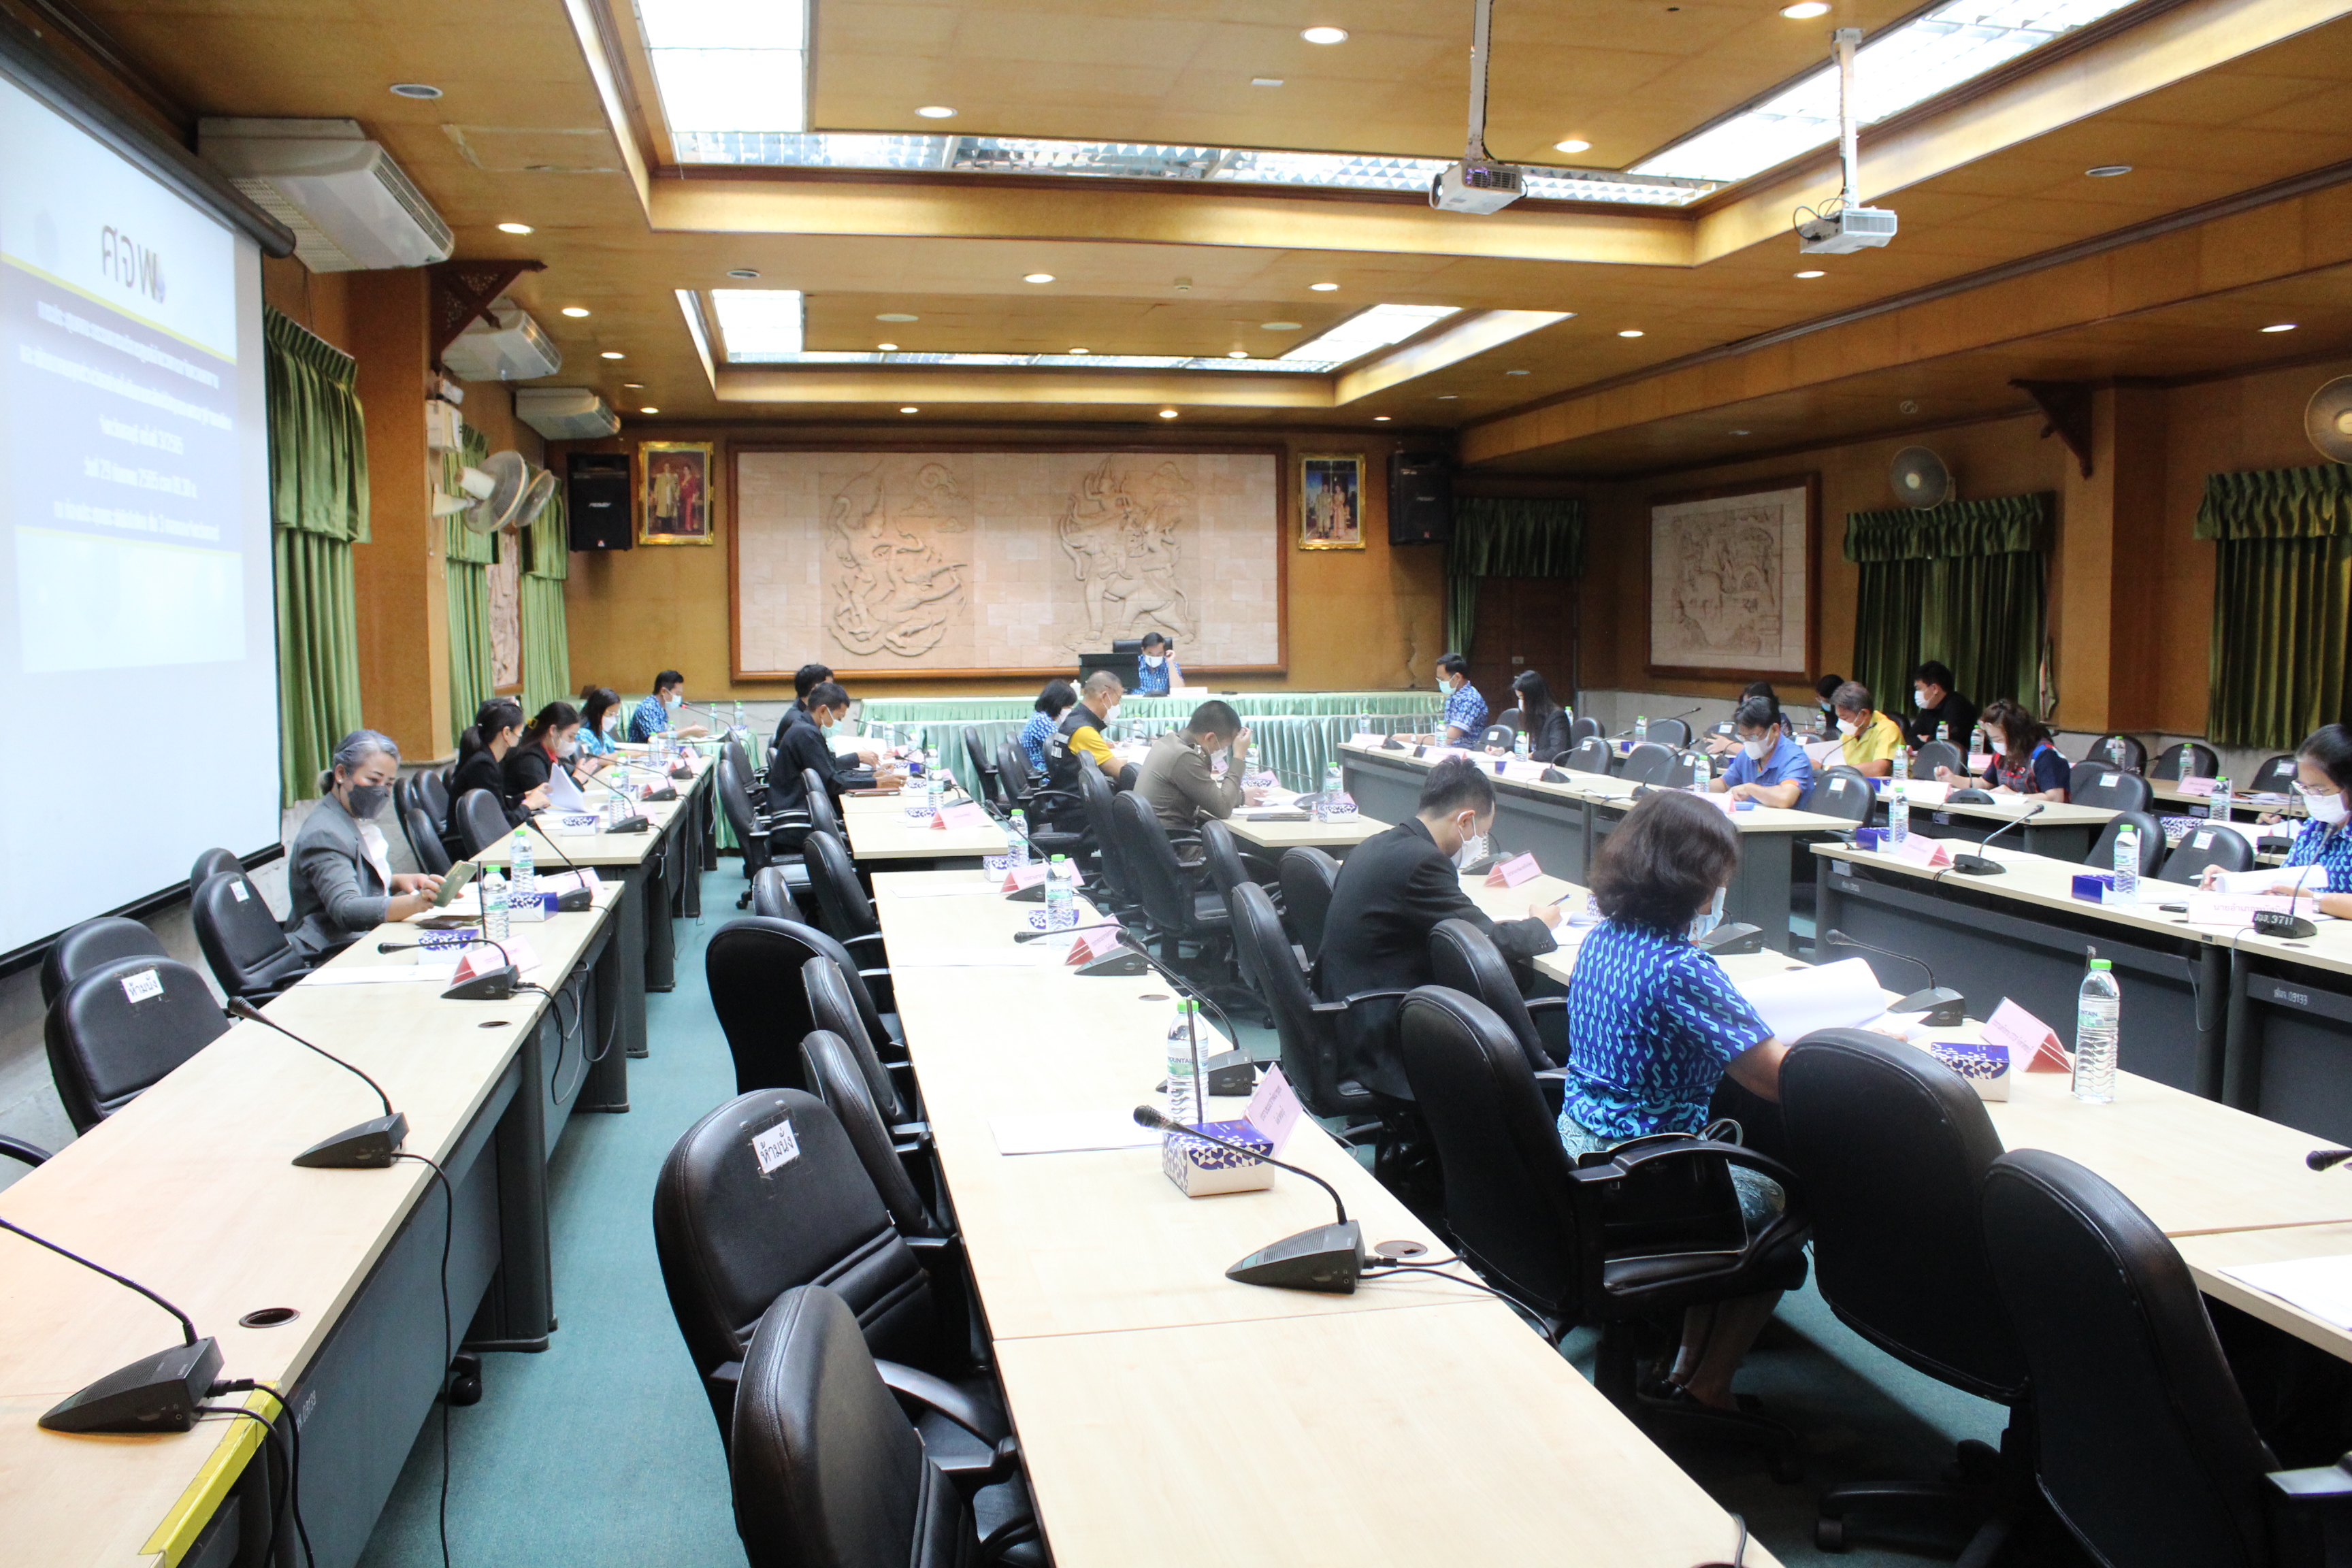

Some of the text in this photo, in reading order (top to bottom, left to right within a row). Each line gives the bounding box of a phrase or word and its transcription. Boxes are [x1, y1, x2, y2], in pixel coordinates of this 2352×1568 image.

[128, 974, 159, 997] ห้ามนั่ง
[760, 1127, 794, 1164] ห้ามนั่ง
